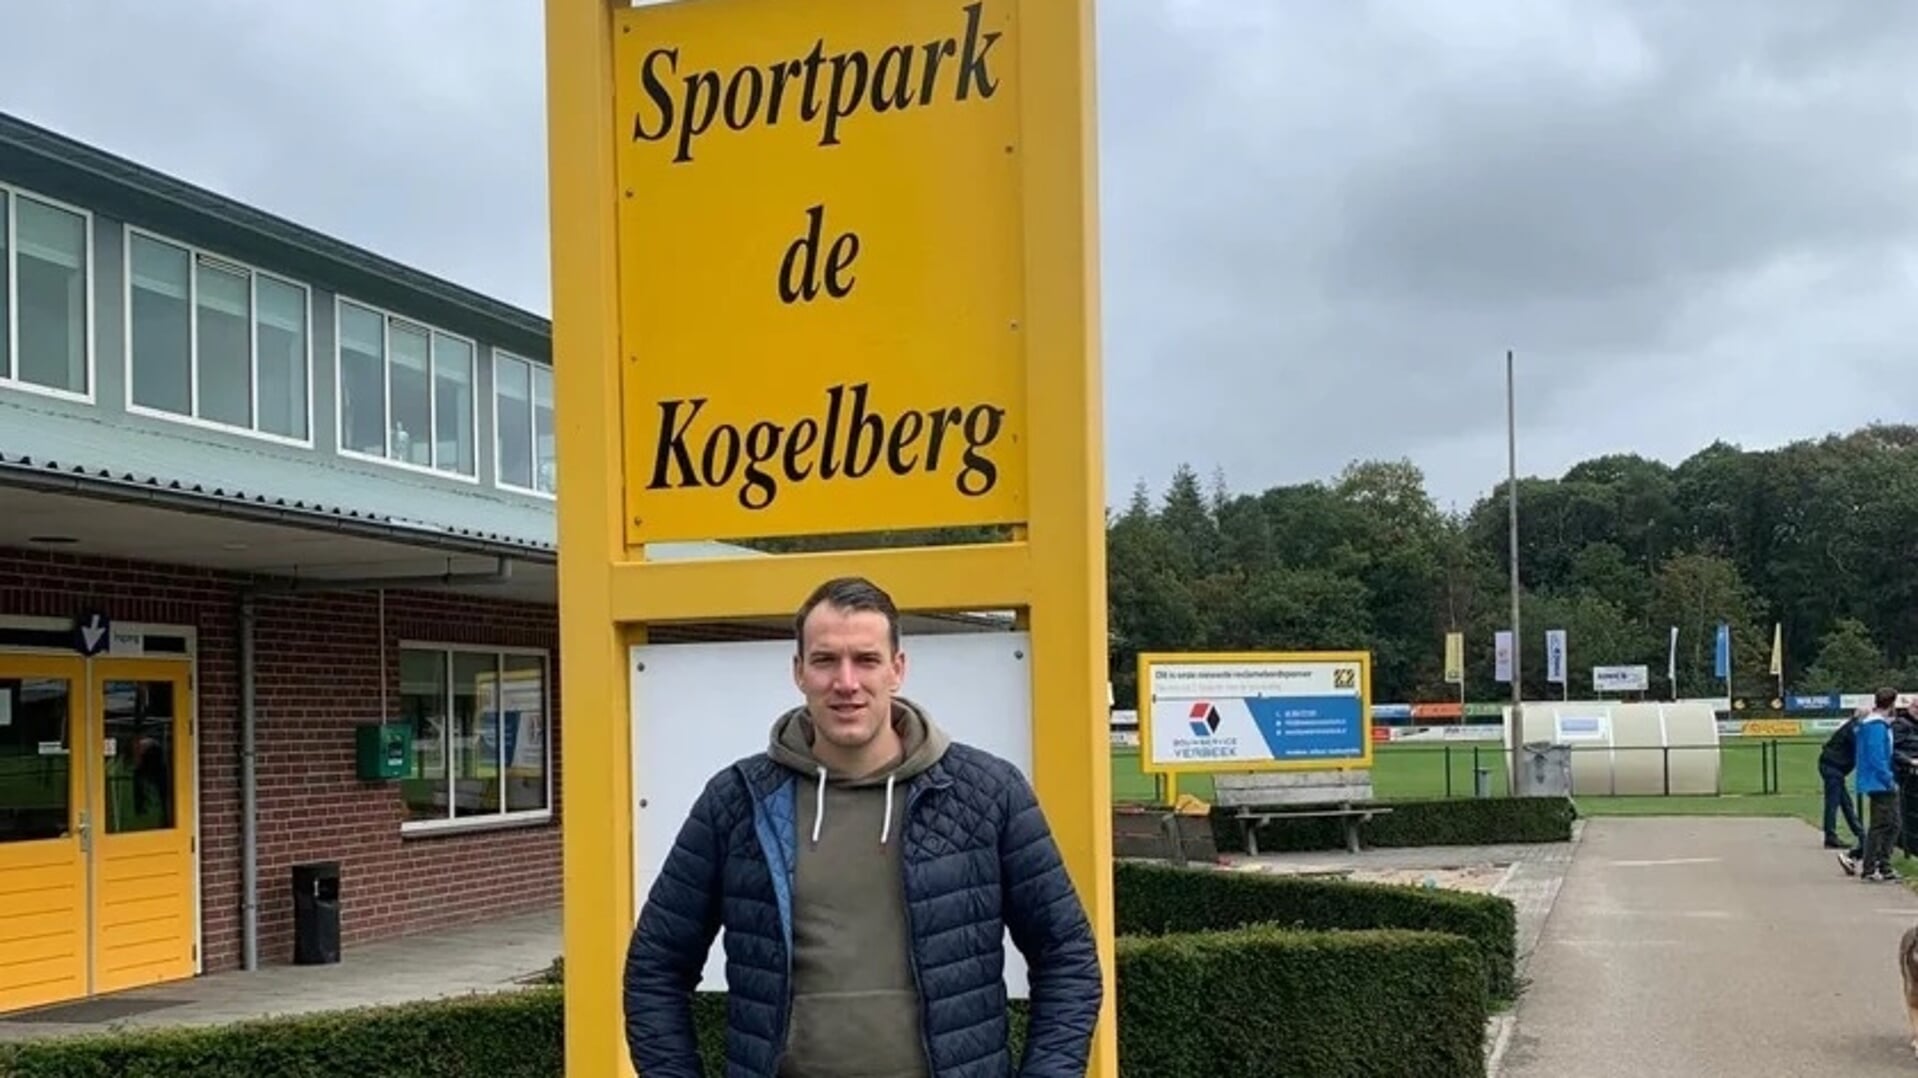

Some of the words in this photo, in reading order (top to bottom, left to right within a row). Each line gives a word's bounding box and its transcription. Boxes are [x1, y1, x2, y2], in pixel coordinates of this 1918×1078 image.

[633, 2, 1002, 163] Sportpark
[778, 205, 859, 304] de
[646, 383, 1005, 510] Kogelberg
